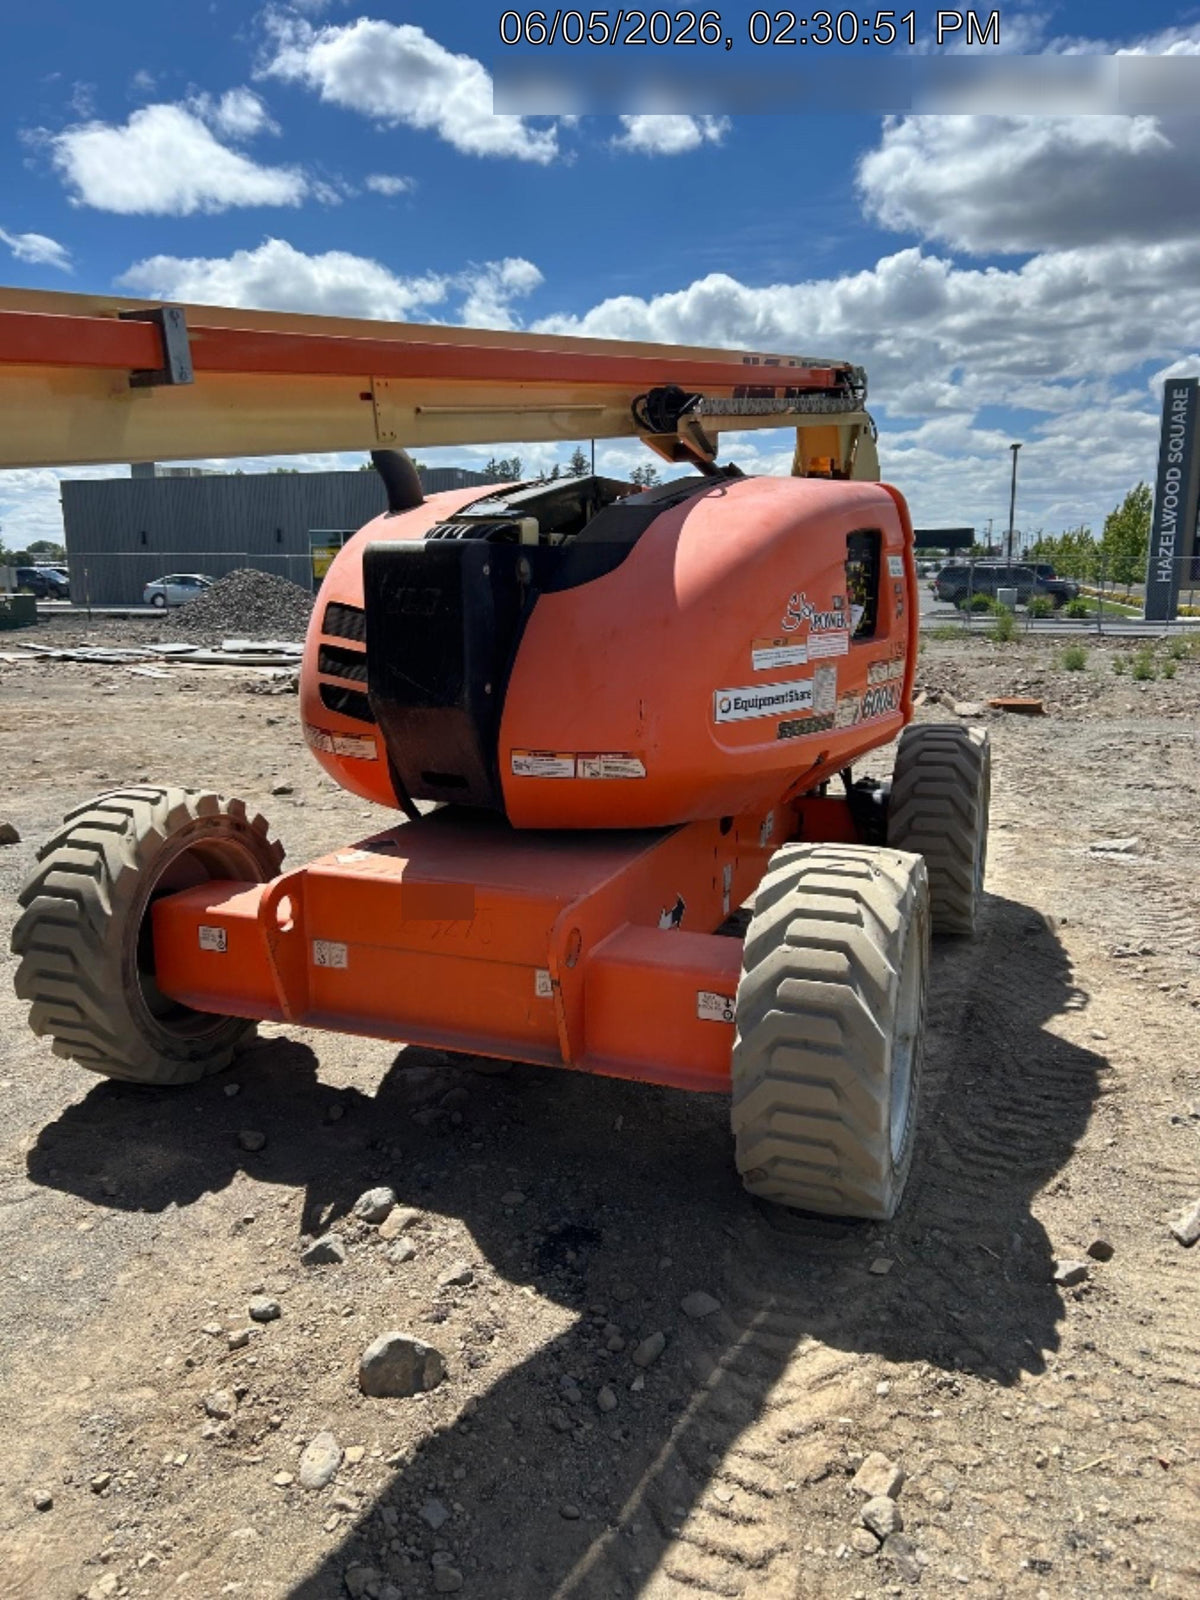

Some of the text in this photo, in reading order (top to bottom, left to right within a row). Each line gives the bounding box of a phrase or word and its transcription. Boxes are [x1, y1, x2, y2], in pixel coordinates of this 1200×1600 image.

[1155, 387, 1190, 583] HAZELWOOD SQUARE
[733, 689, 812, 712] EquipmentShare
